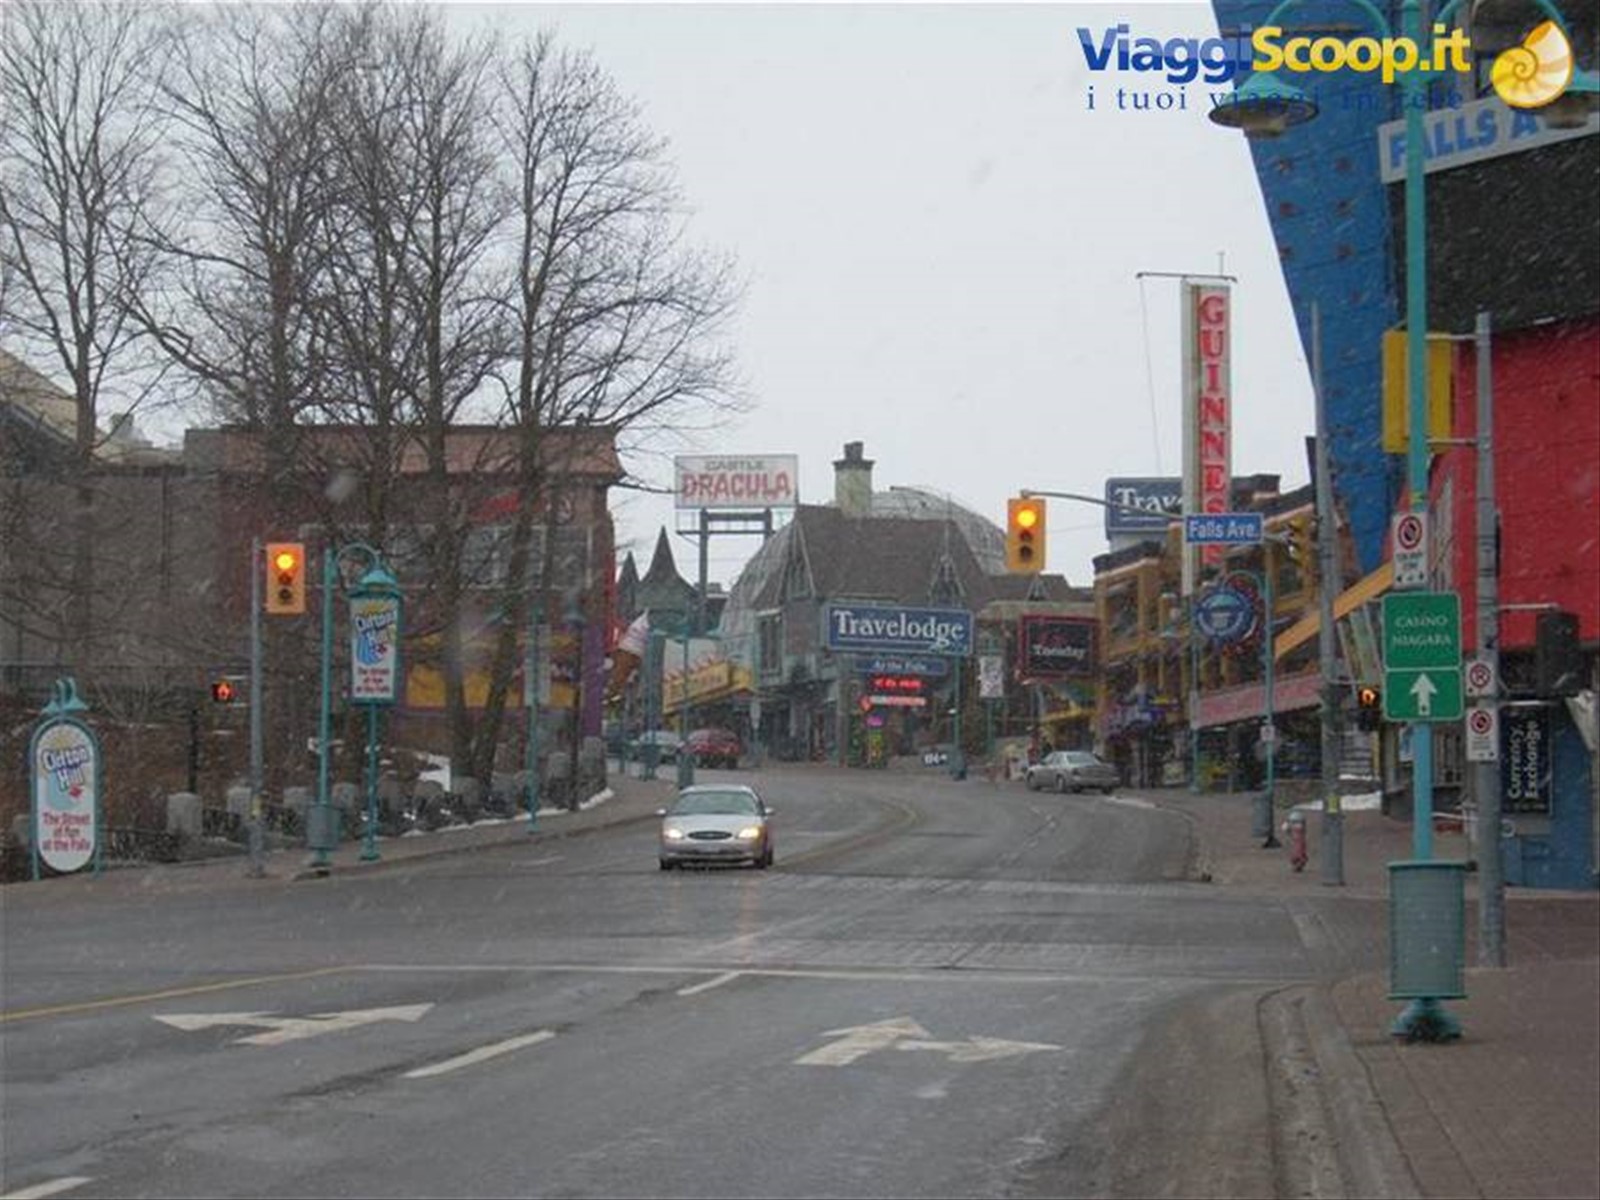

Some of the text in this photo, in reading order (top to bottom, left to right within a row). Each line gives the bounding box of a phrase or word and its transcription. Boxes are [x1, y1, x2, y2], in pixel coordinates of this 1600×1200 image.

[682, 471, 792, 500] DRACULA
[1189, 519, 1260, 538] Falls Ave.
[833, 609, 965, 648] Travelodge
[1395, 614, 1449, 628] CASINO
[1392, 633, 1452, 647] NIAGARA
[1032, 644, 1086, 661] Tuesday
[1508, 726, 1525, 799] Currency
[1524, 720, 1541, 798] Exchange
